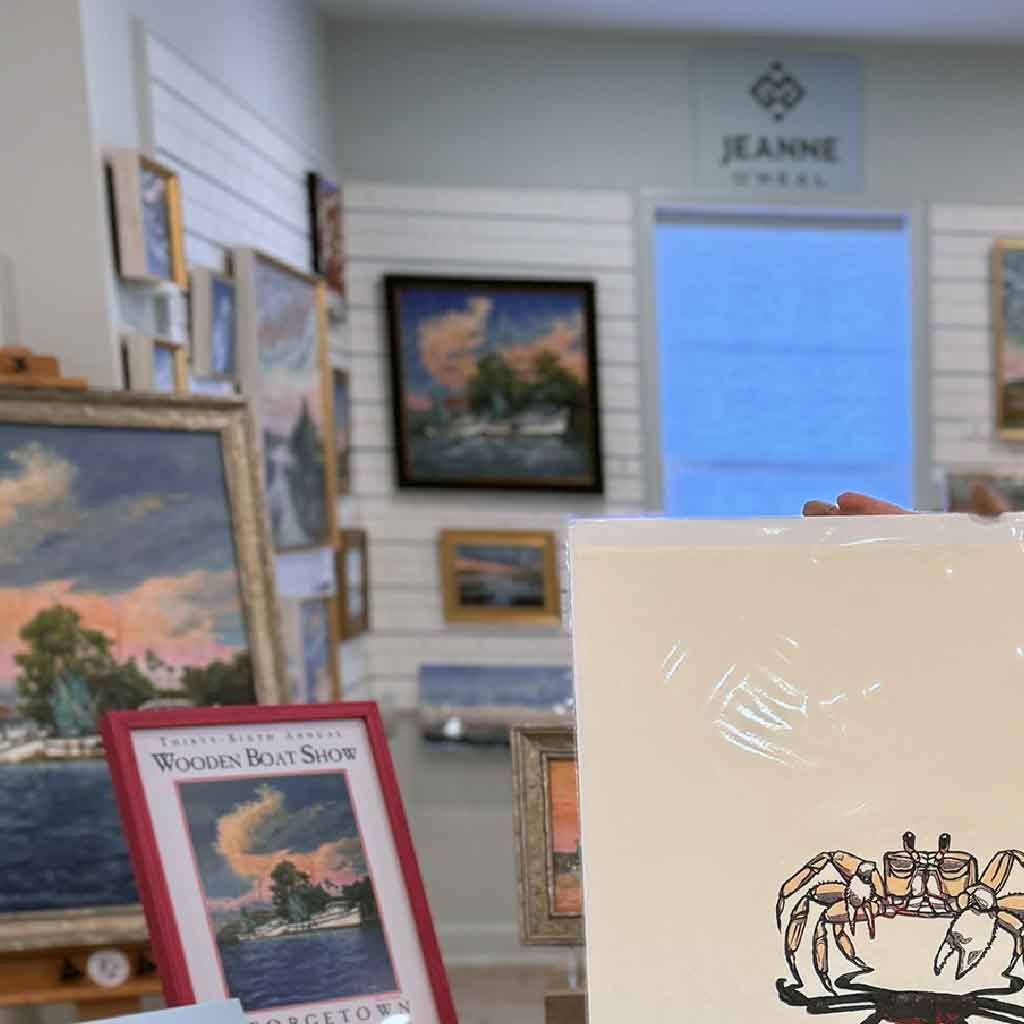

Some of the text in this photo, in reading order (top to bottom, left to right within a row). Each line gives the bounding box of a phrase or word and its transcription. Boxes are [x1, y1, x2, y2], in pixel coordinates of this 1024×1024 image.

[719, 133, 839, 168] JEANNE
[152, 743, 358, 774] WOODEN BOAT SHOW
